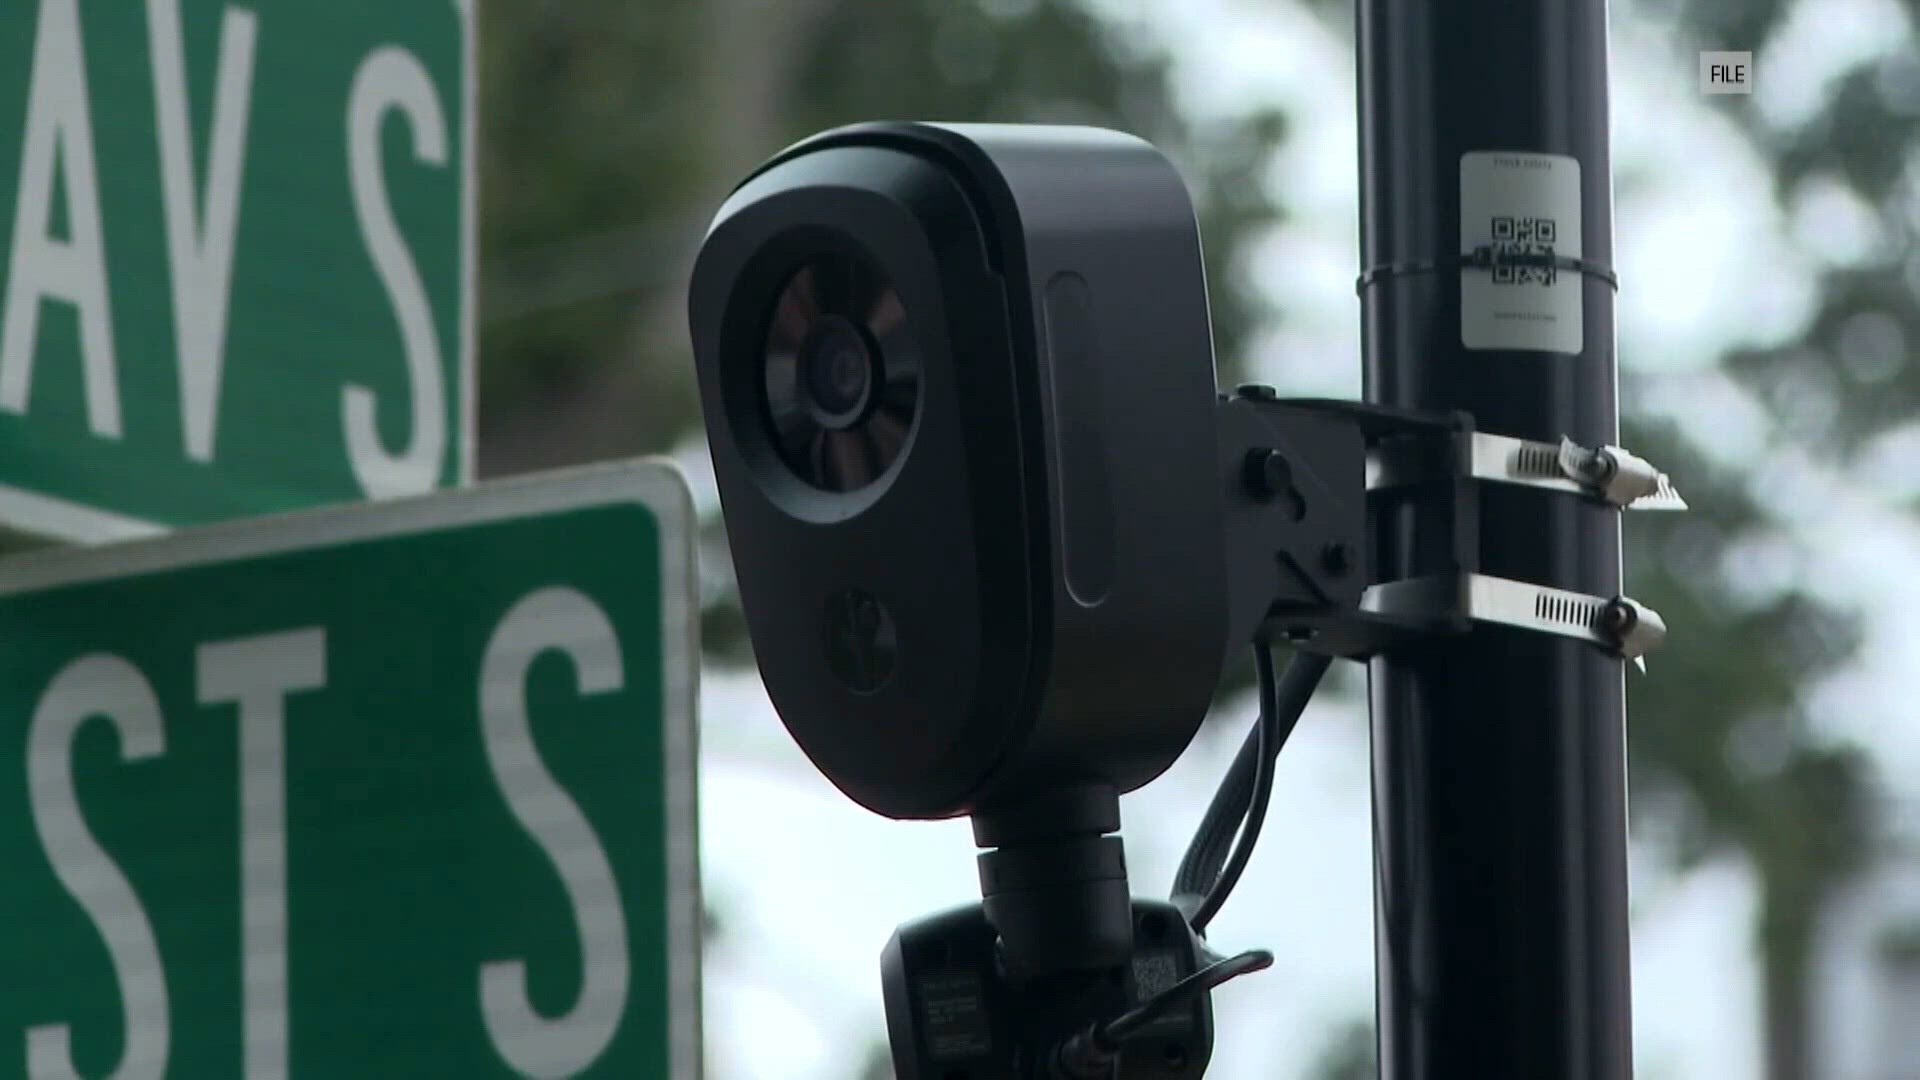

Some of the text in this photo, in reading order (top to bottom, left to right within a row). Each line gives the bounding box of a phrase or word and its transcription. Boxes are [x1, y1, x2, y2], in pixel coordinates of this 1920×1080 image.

[0, 0, 449, 500] AV S
[25, 585, 630, 1080] ST S
